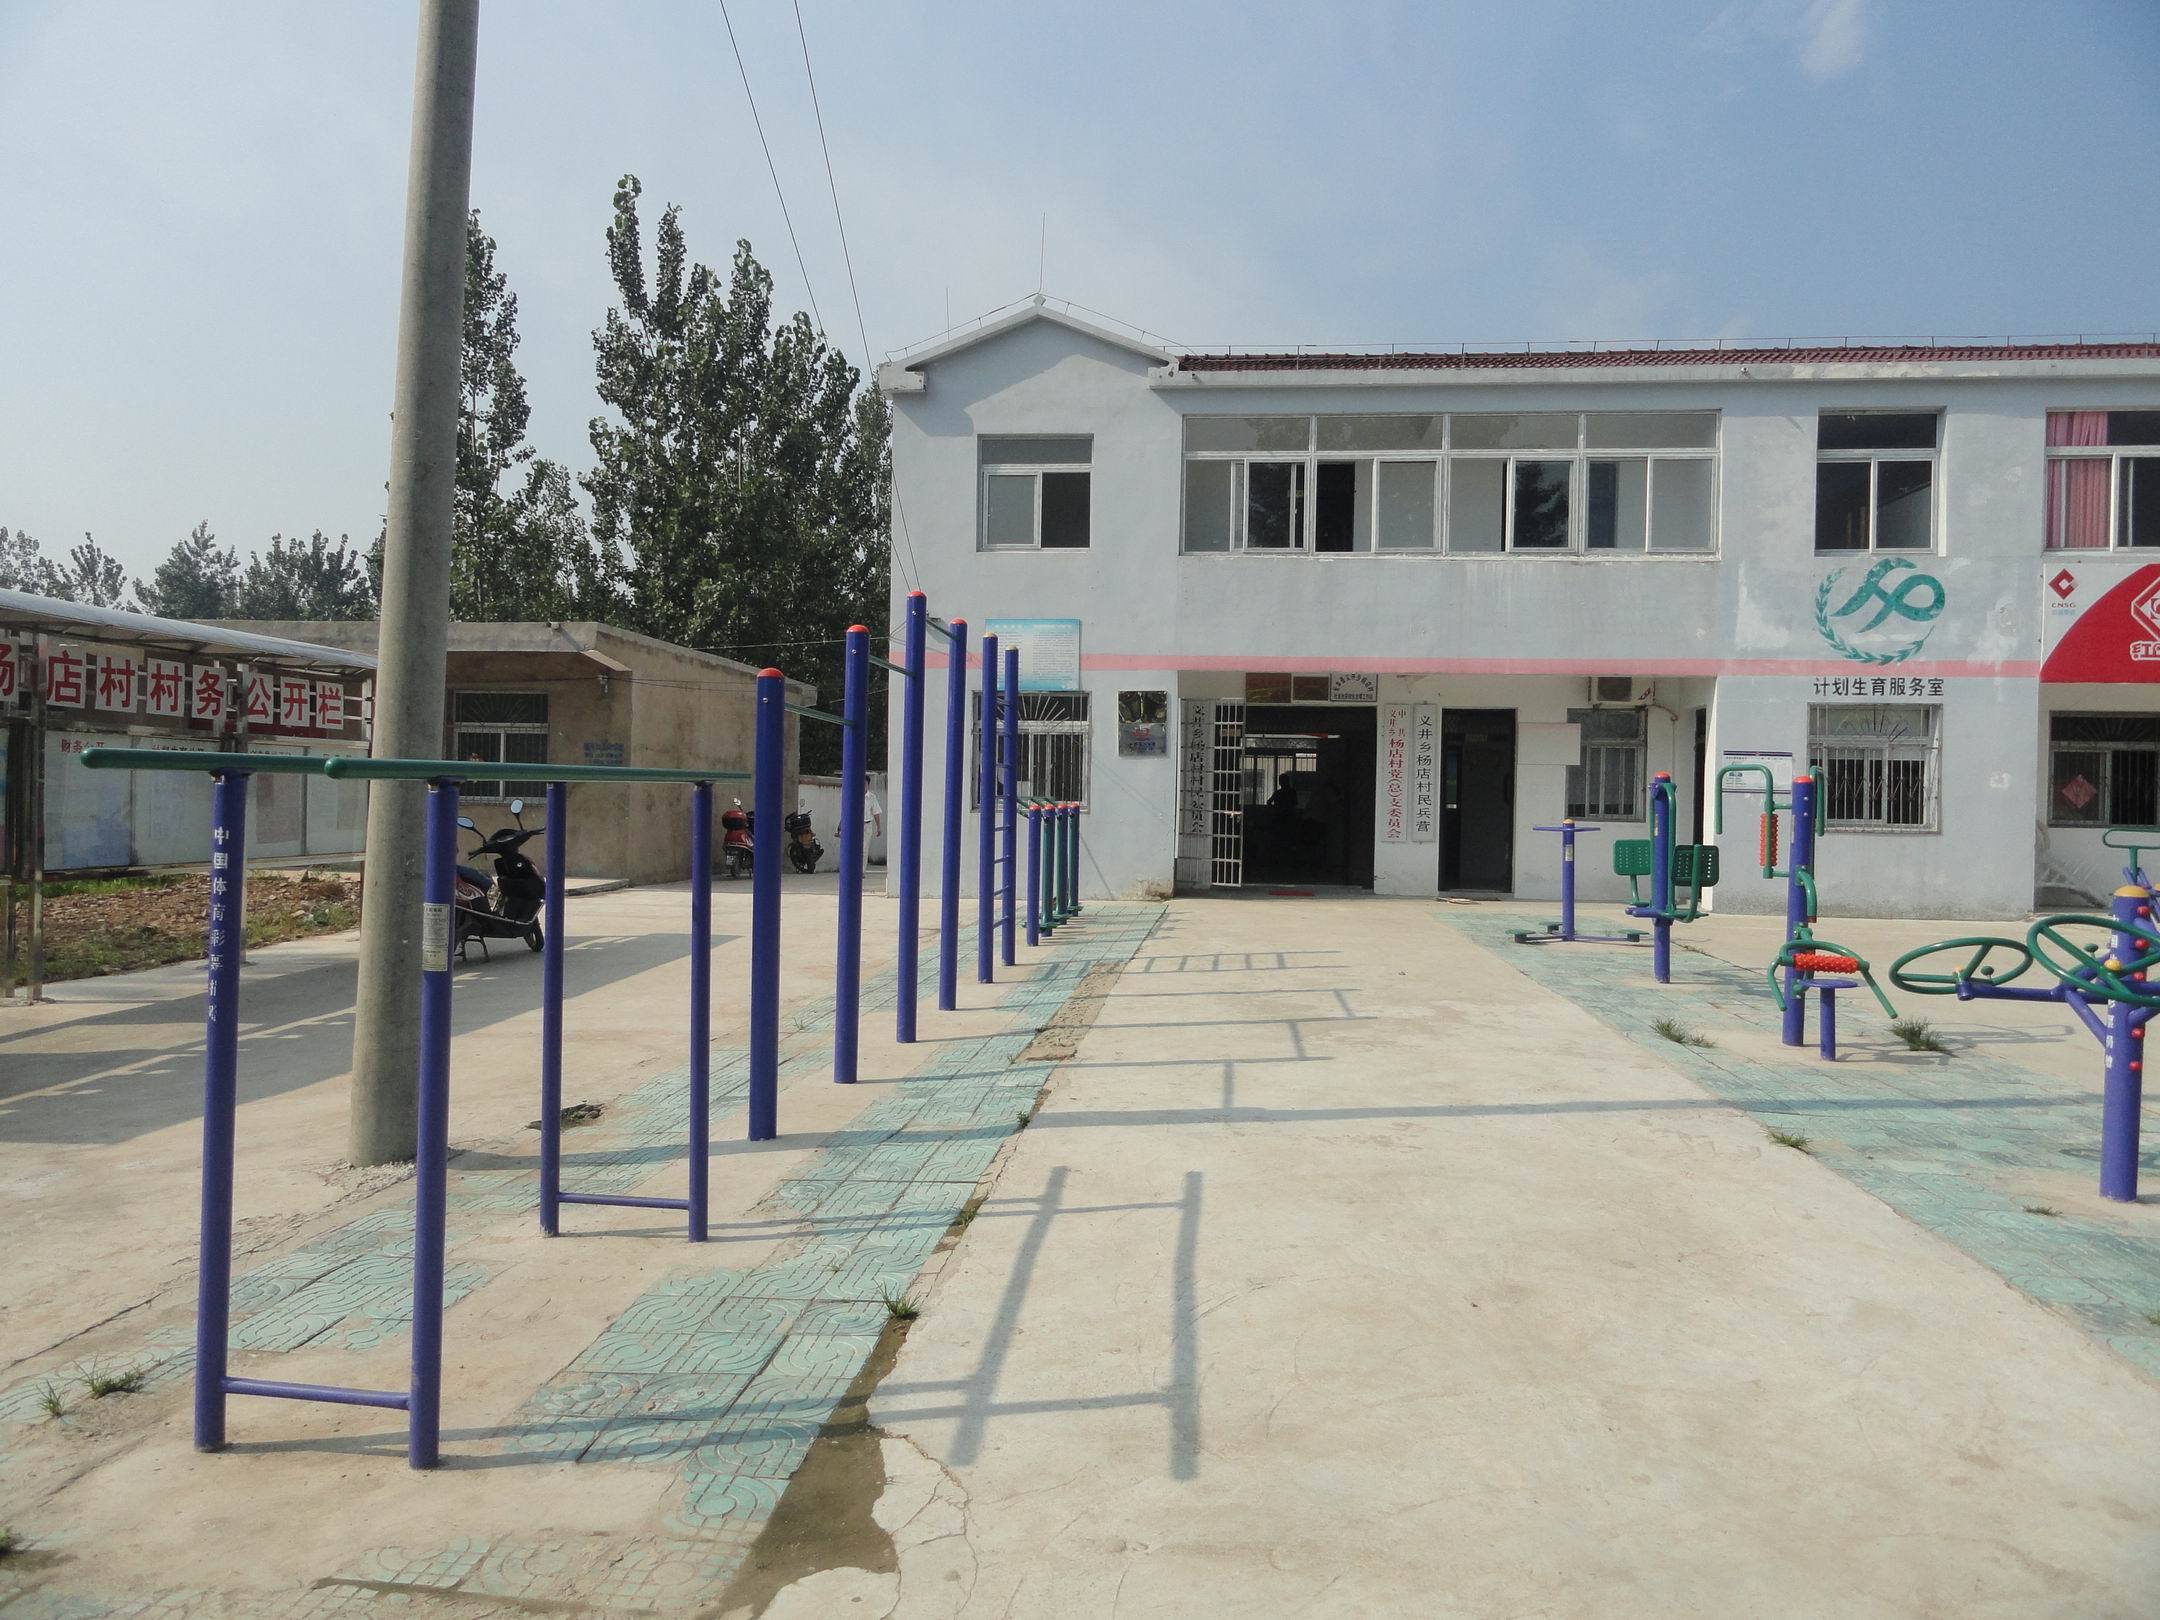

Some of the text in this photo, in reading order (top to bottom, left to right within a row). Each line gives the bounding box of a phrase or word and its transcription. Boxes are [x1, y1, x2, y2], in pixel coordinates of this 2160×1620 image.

[1813, 677, 1944, 697] 计划生育服务室
[1416, 715, 1433, 833] 义井乡杨店村民兵营
